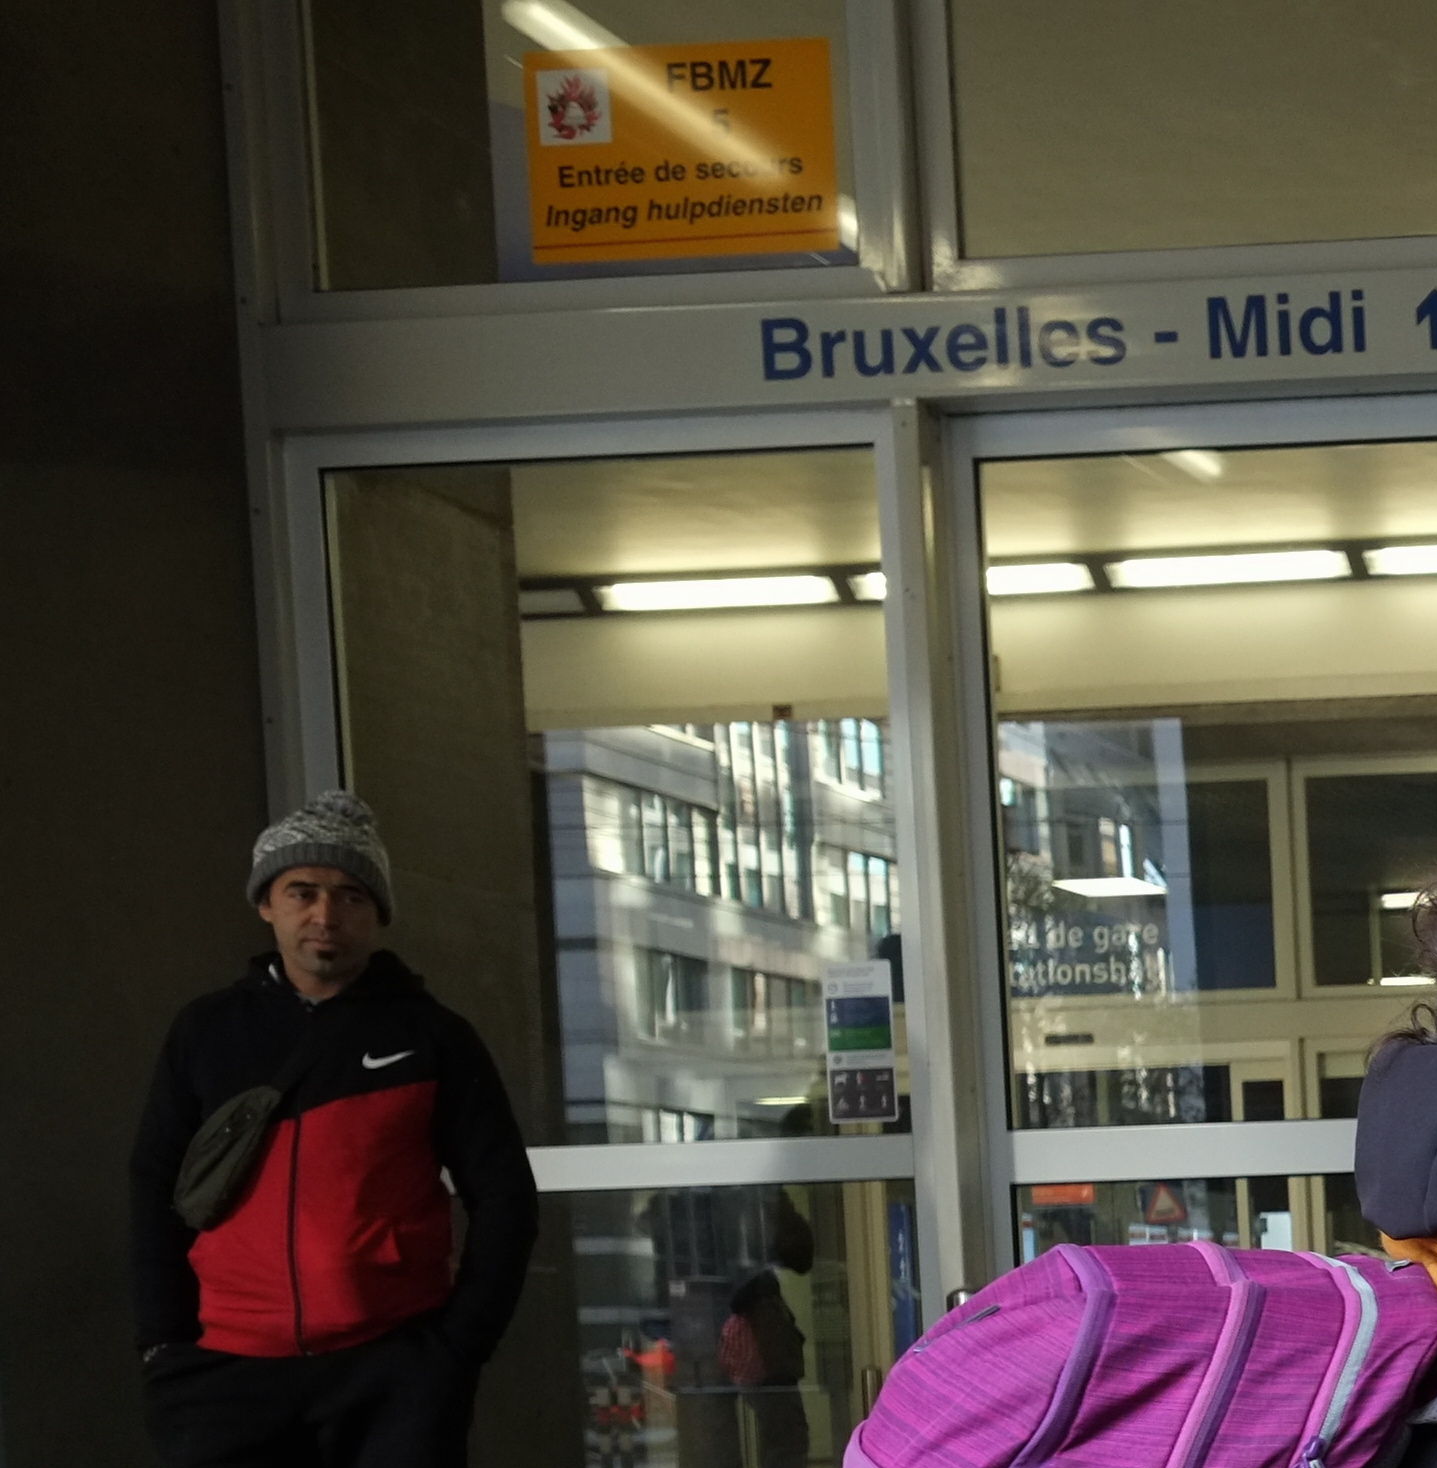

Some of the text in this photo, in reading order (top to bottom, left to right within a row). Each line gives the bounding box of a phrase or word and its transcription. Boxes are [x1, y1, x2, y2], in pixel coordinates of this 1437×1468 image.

[665, 58, 773, 95] FBMZ
[557, 155, 804, 189] Entrée de secors
[546, 190, 824, 230] Ingang hulpdiensten
[760, 288, 1367, 381] Bruxelles - Midi
